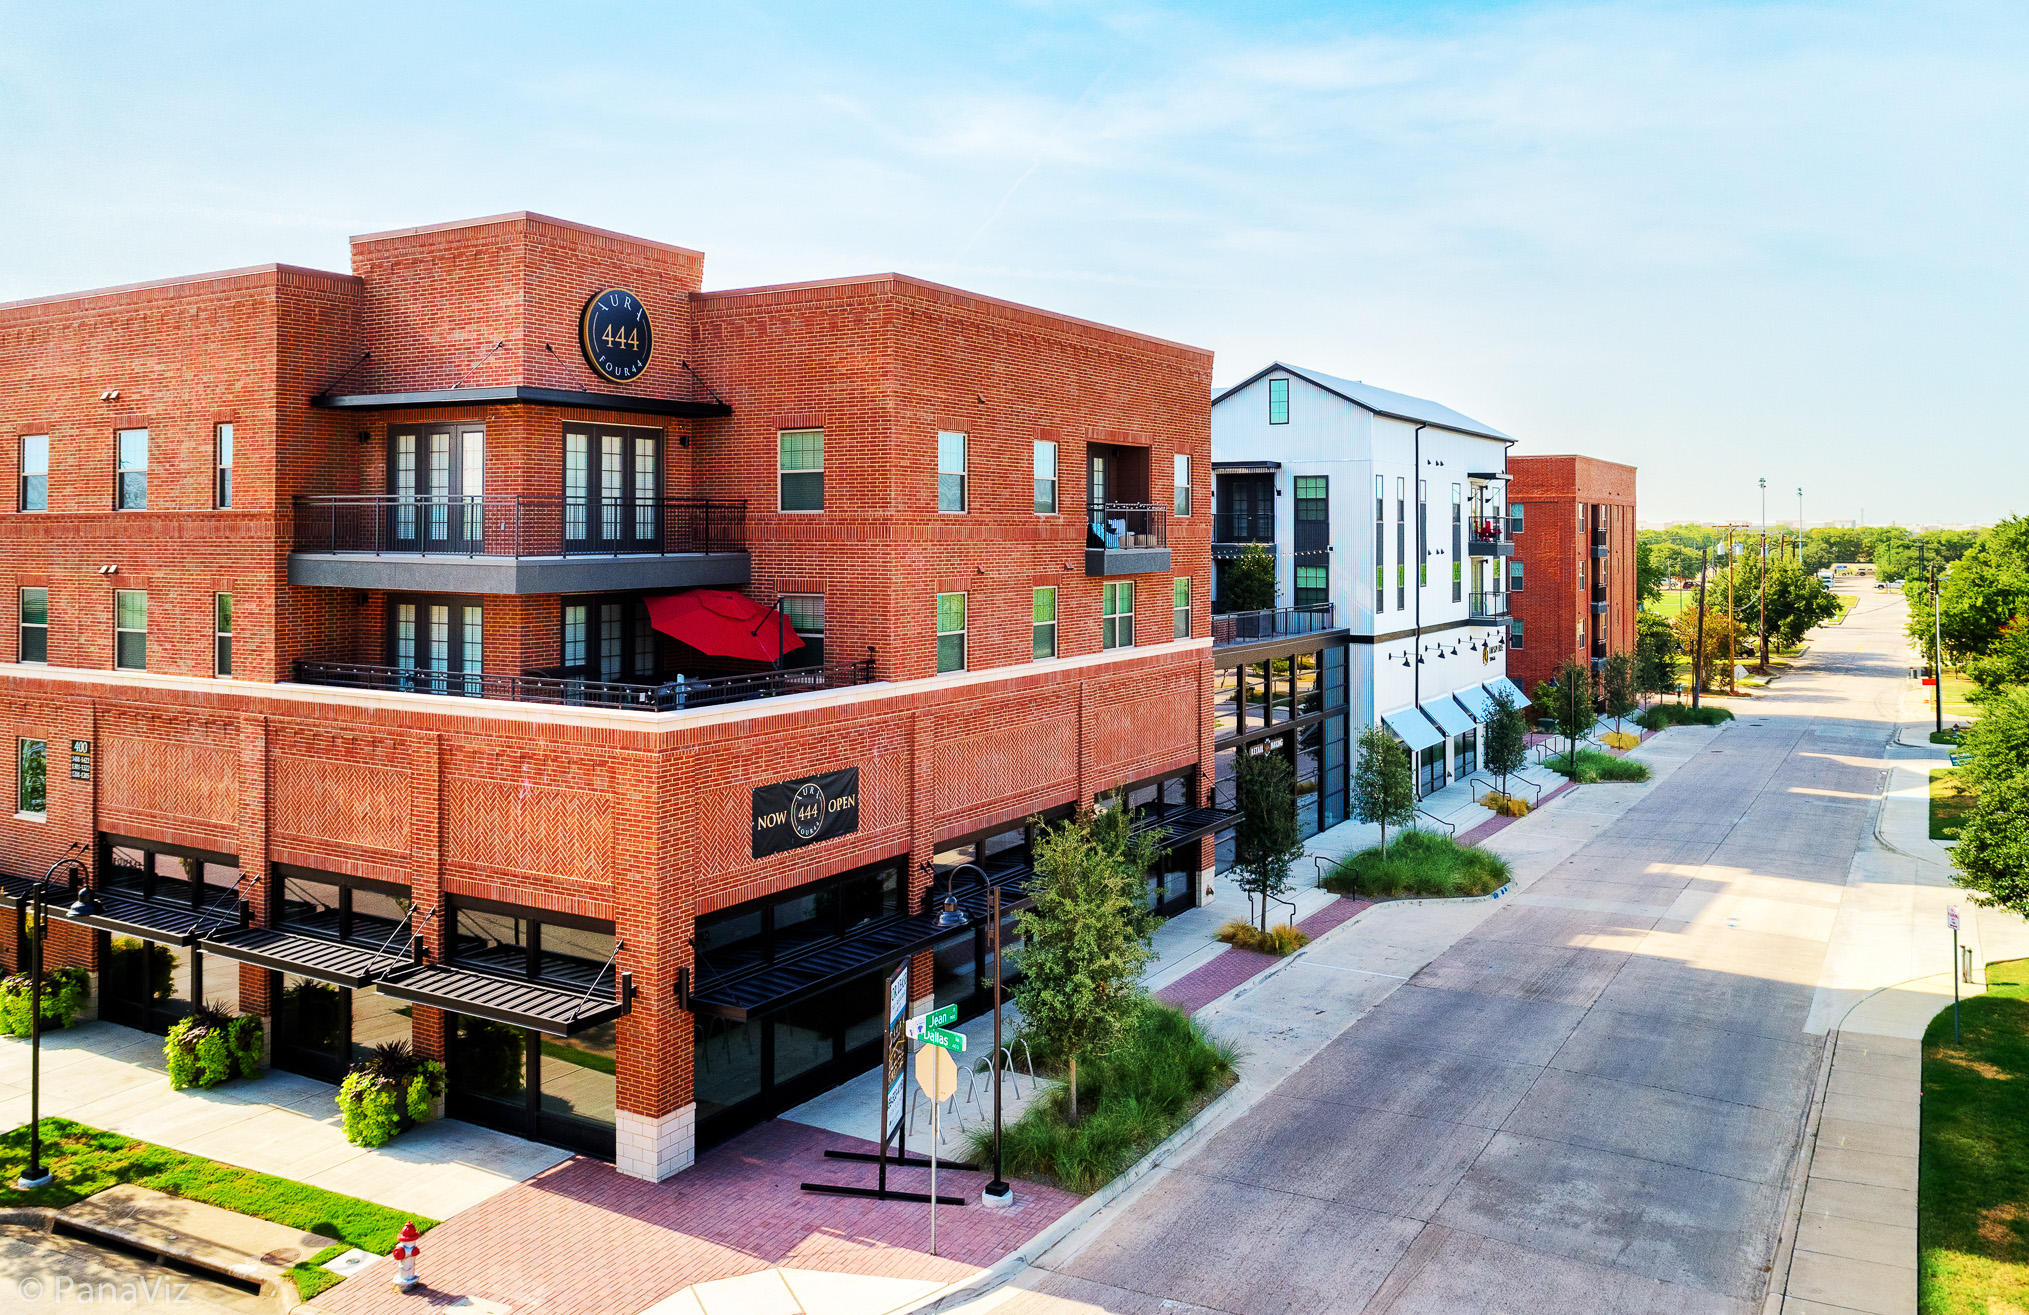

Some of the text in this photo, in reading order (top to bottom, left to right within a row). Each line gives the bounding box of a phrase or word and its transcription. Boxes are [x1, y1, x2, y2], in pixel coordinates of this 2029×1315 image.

[598, 294, 643, 322] AURA
[602, 323, 640, 351] 444
[599, 355, 643, 376] FOUR44
[74, 741, 88, 753] 400
[798, 803, 818, 821] 444
[828, 793, 856, 813] OPEN
[757, 810, 787, 831] NOW
[929, 1013, 947, 1028] Jean
[923, 1030, 949, 1047] Dallas
